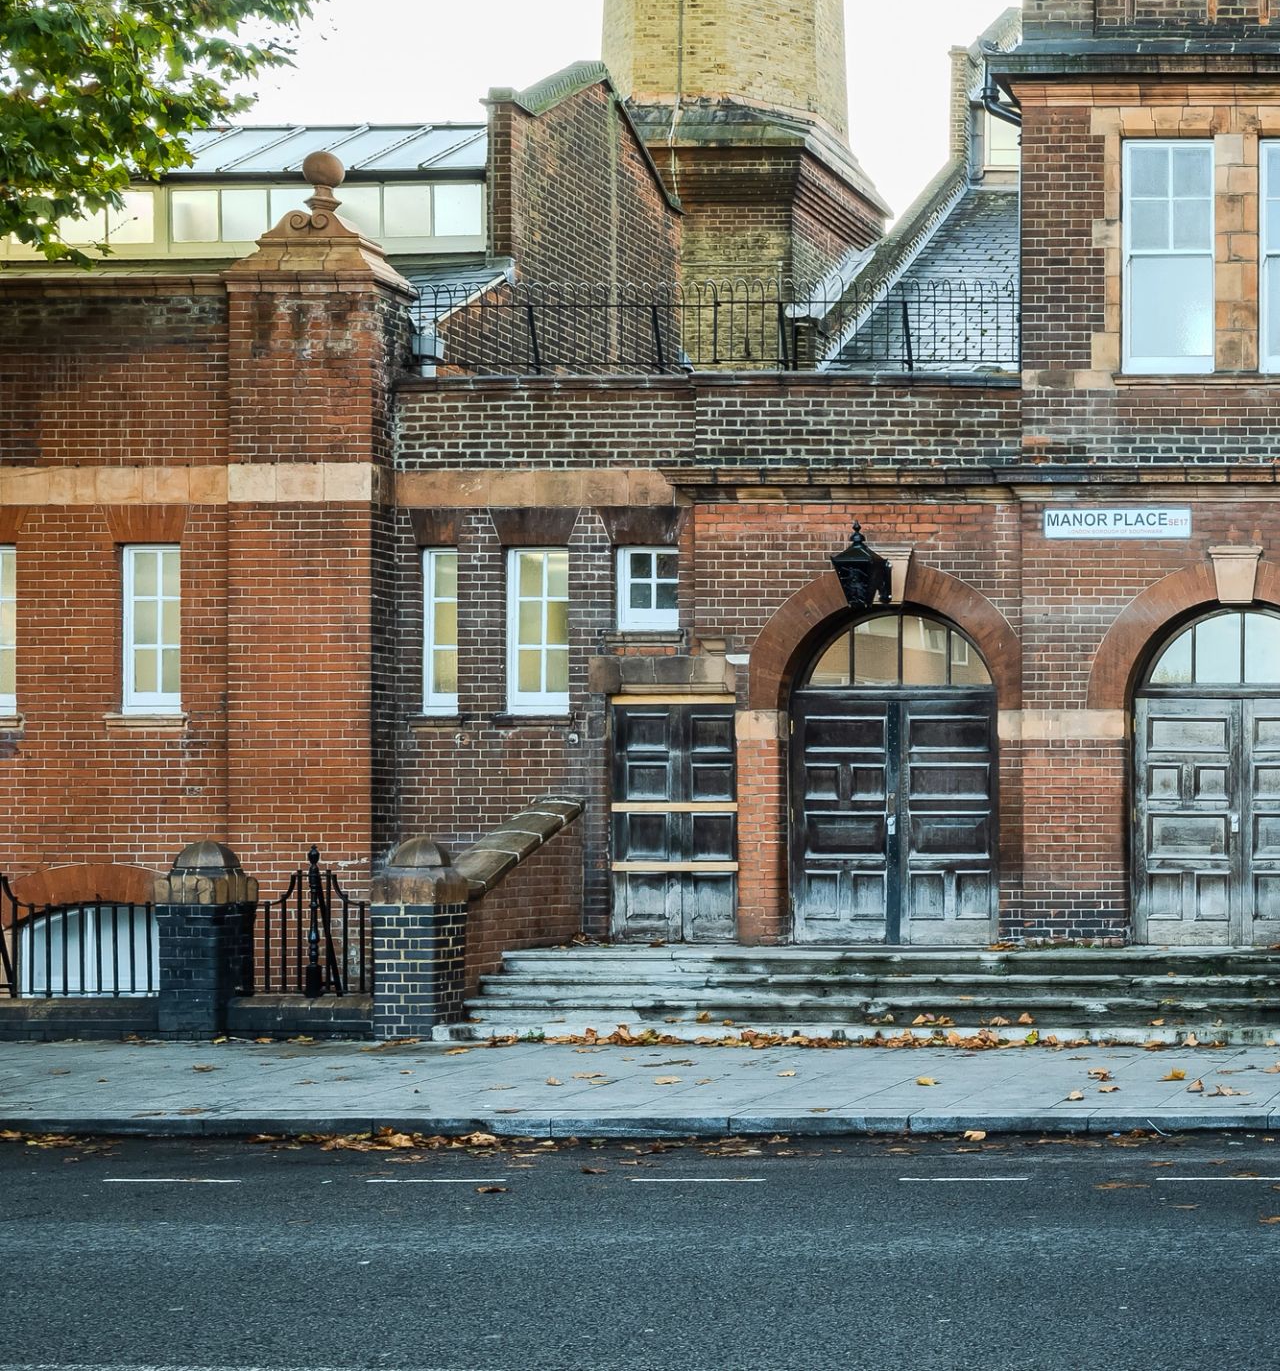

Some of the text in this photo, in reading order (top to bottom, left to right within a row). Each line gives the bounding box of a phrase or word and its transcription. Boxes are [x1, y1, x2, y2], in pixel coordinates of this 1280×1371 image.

[1047, 512, 1188, 526] MANOR PLACE SE17
